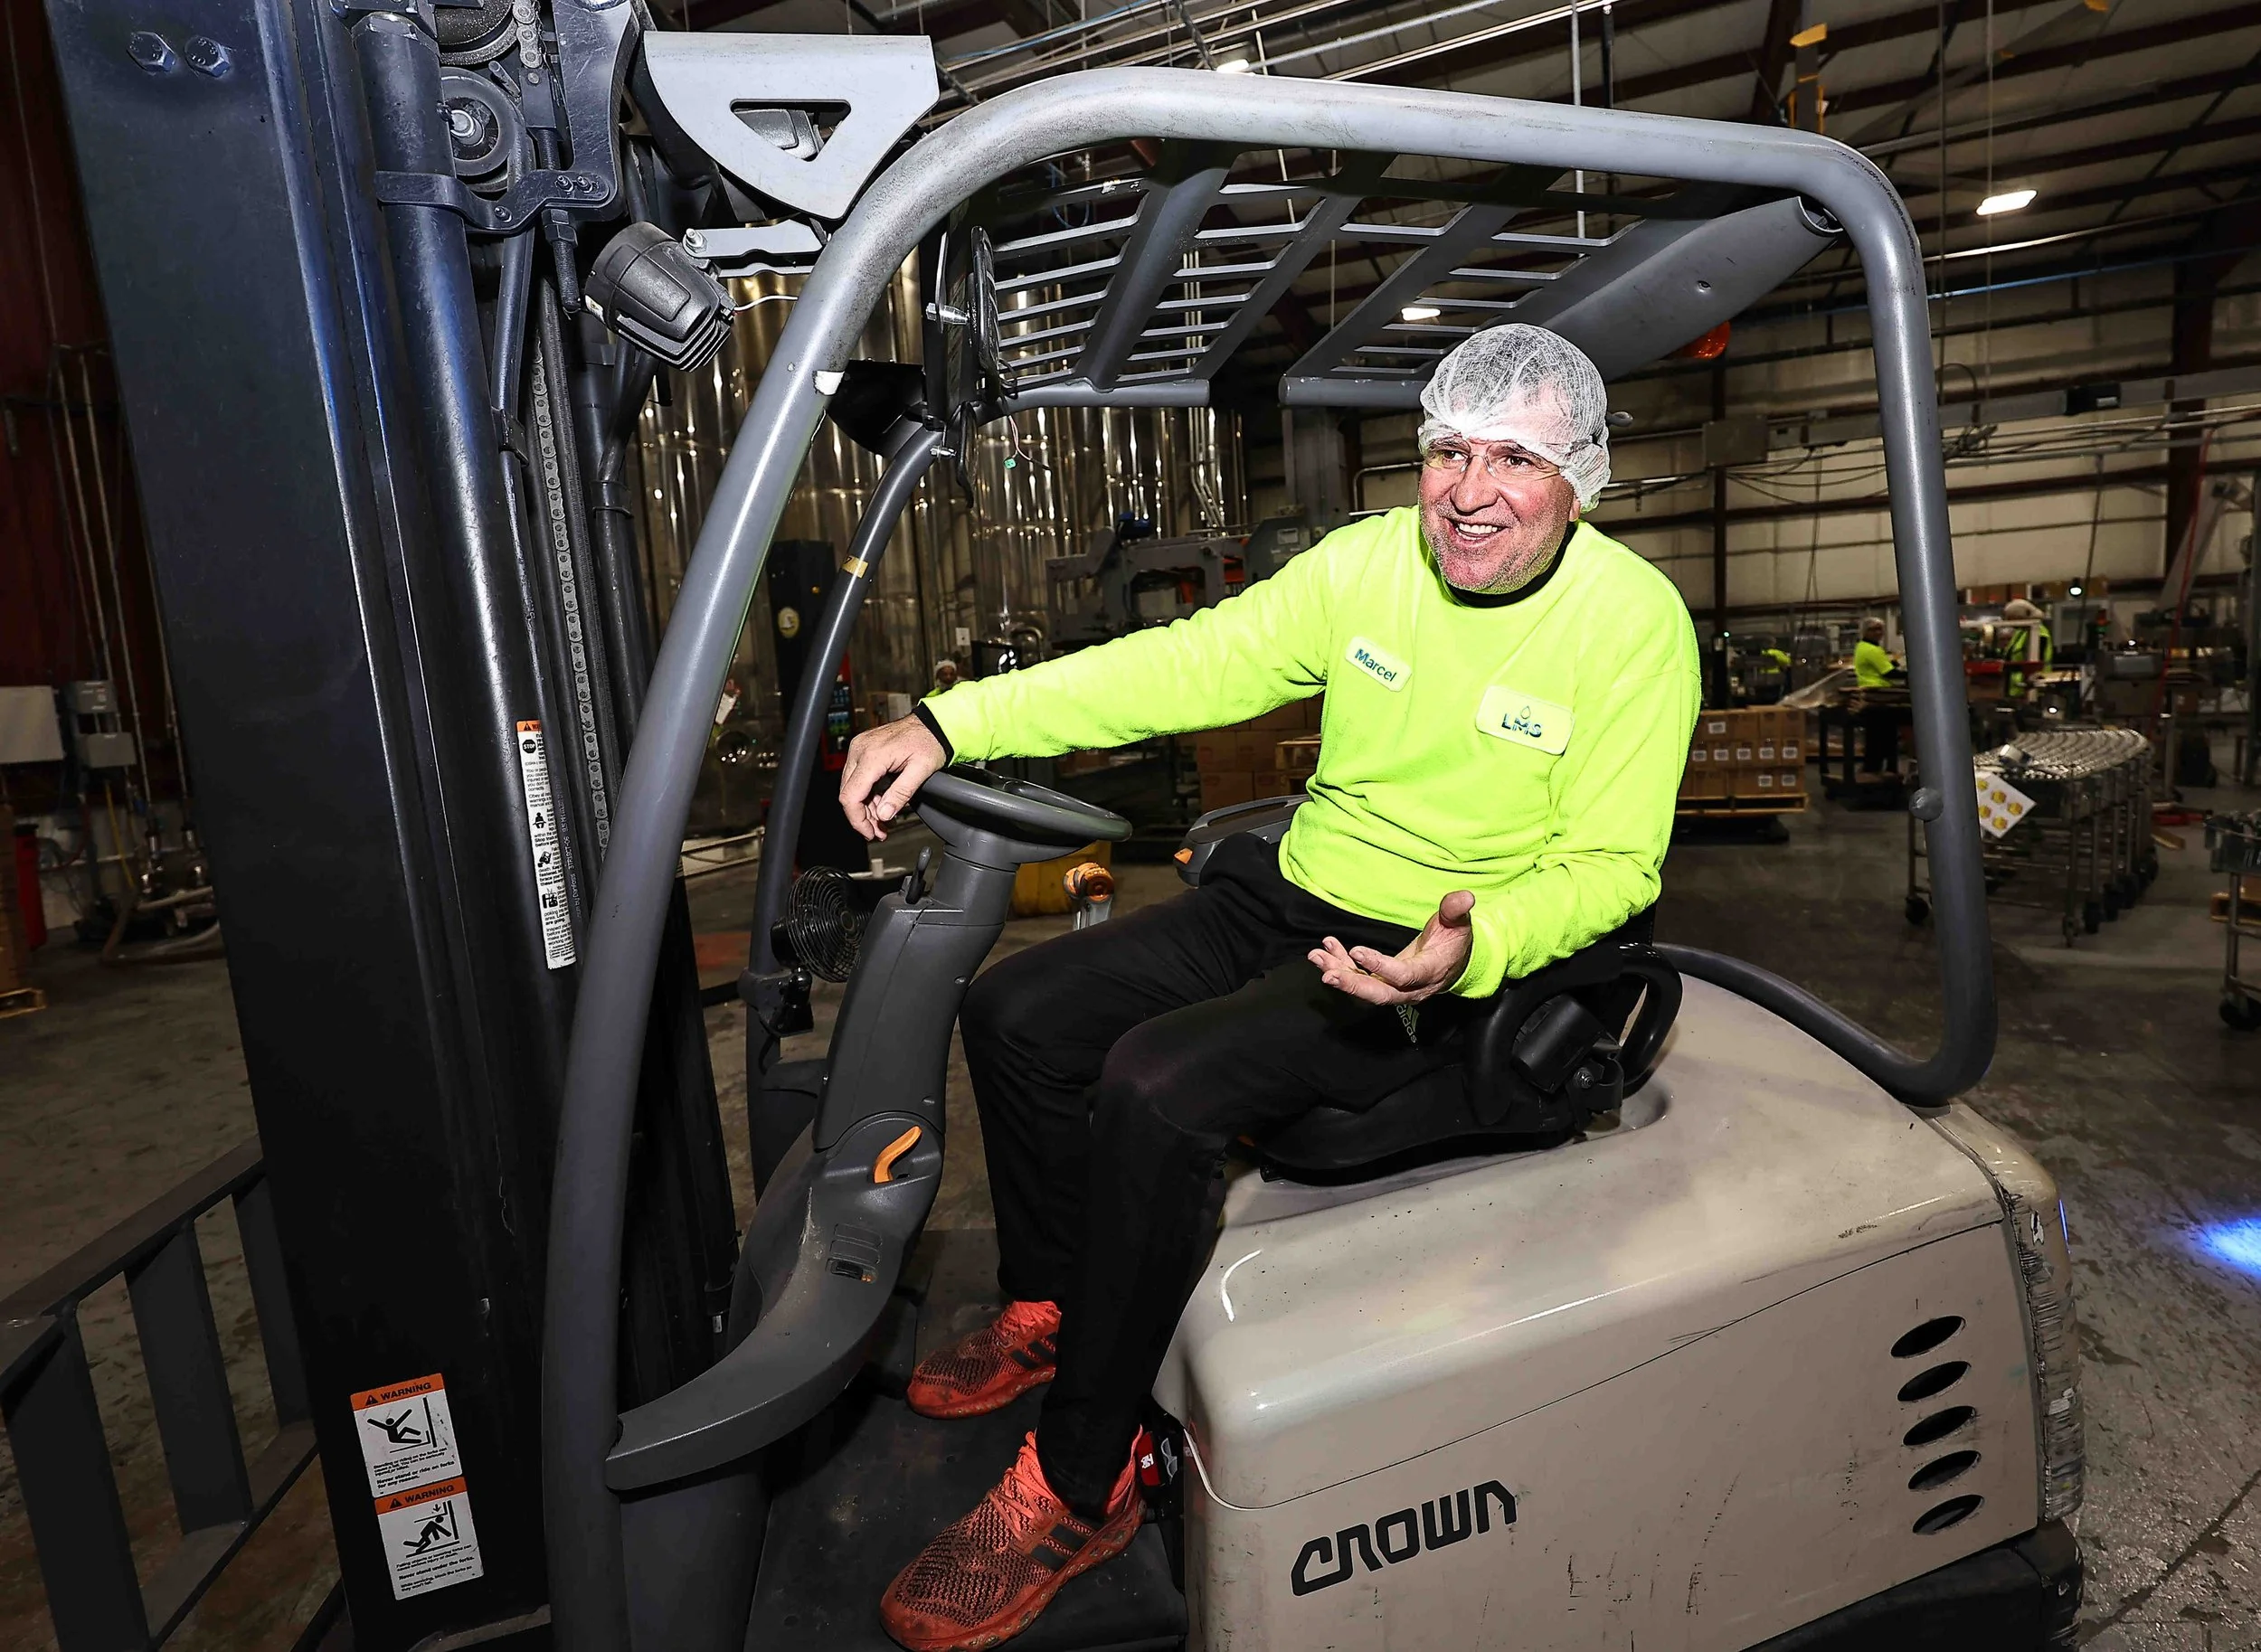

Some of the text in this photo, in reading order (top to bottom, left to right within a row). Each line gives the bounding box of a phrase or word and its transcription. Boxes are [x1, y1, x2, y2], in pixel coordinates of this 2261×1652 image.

[1354, 647, 1396, 683] Marcel
[1501, 713, 1542, 739] LMS
[381, 1383, 431, 1401] WARNING
[405, 1485, 454, 1503] WARNING
[1291, 1479, 1518, 1597] CROWN
